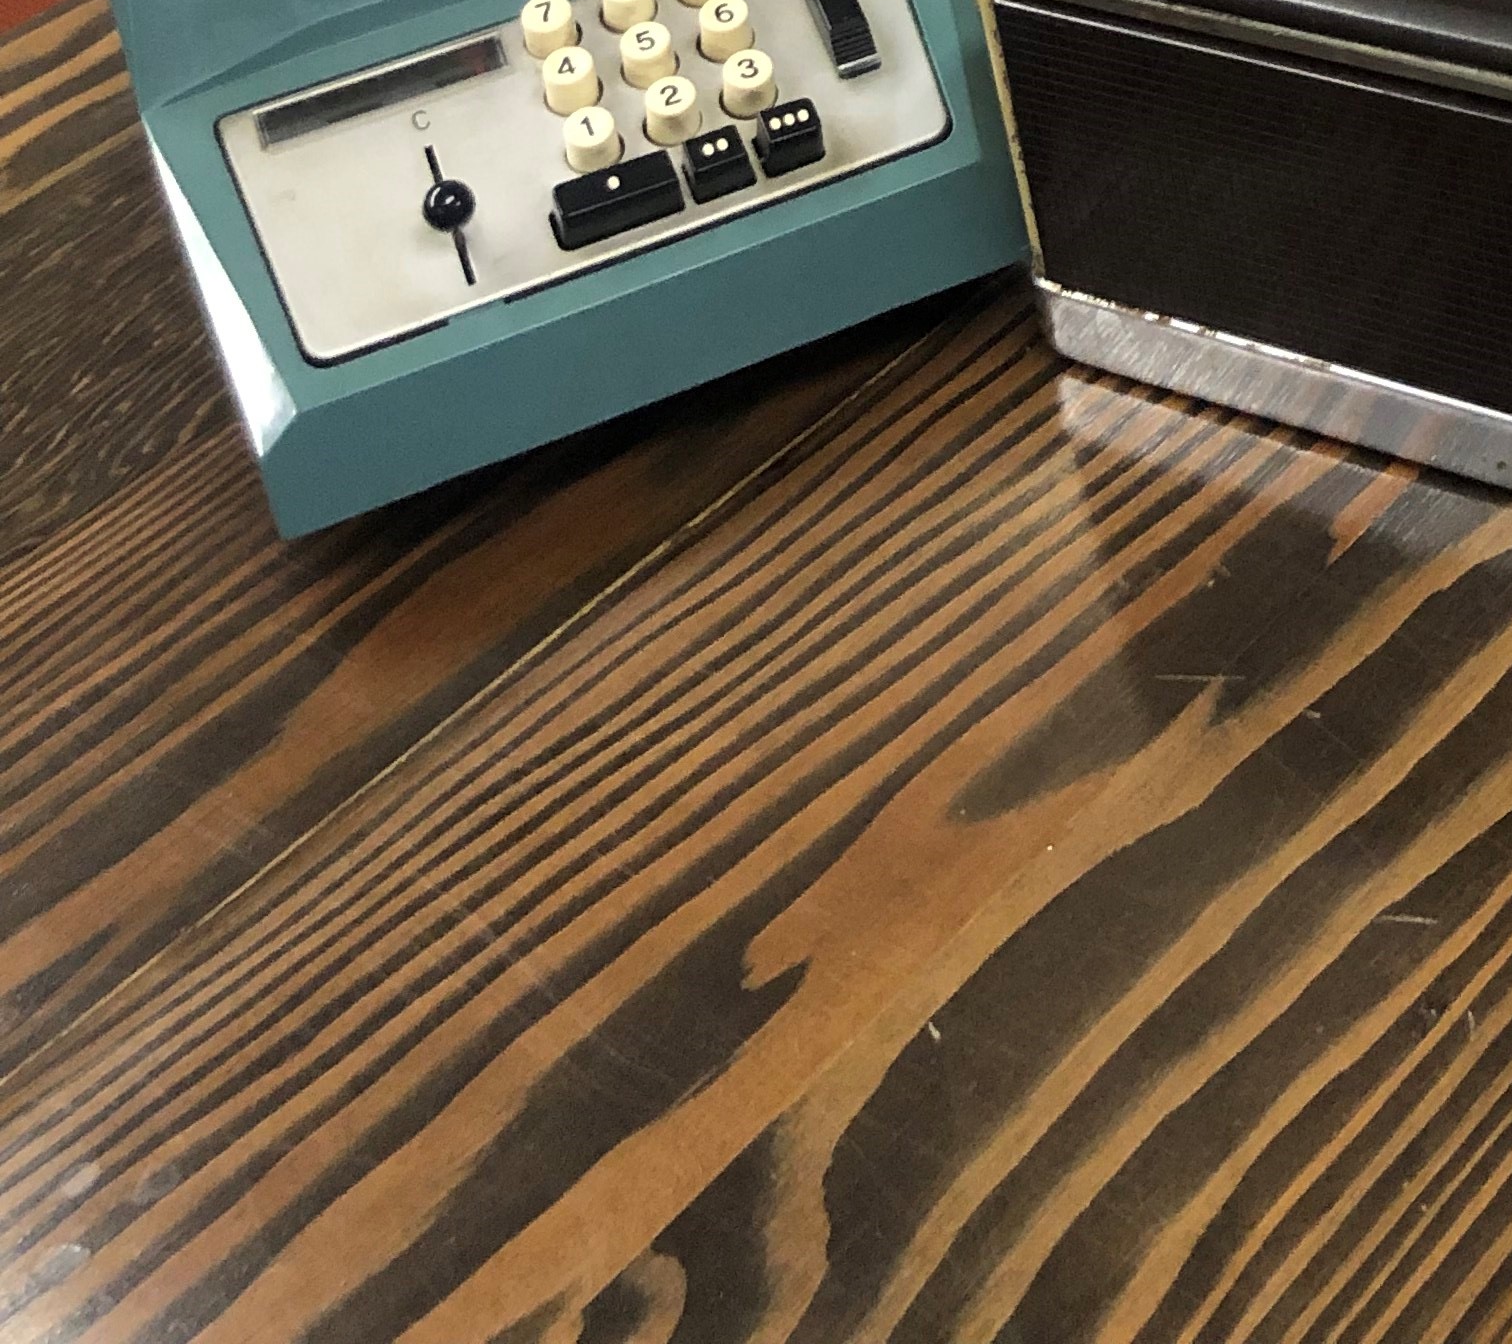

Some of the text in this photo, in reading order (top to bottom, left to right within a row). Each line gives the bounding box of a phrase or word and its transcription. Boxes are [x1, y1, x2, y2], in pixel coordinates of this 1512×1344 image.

[534, 1, 552, 23] 7
[714, 2, 735, 24] 6
[635, 30, 656, 51] 5
[557, 56, 577, 77] 4
[737, 58, 759, 79] 3
[659, 84, 682, 106] 2
[580, 116, 595, 137] 1
